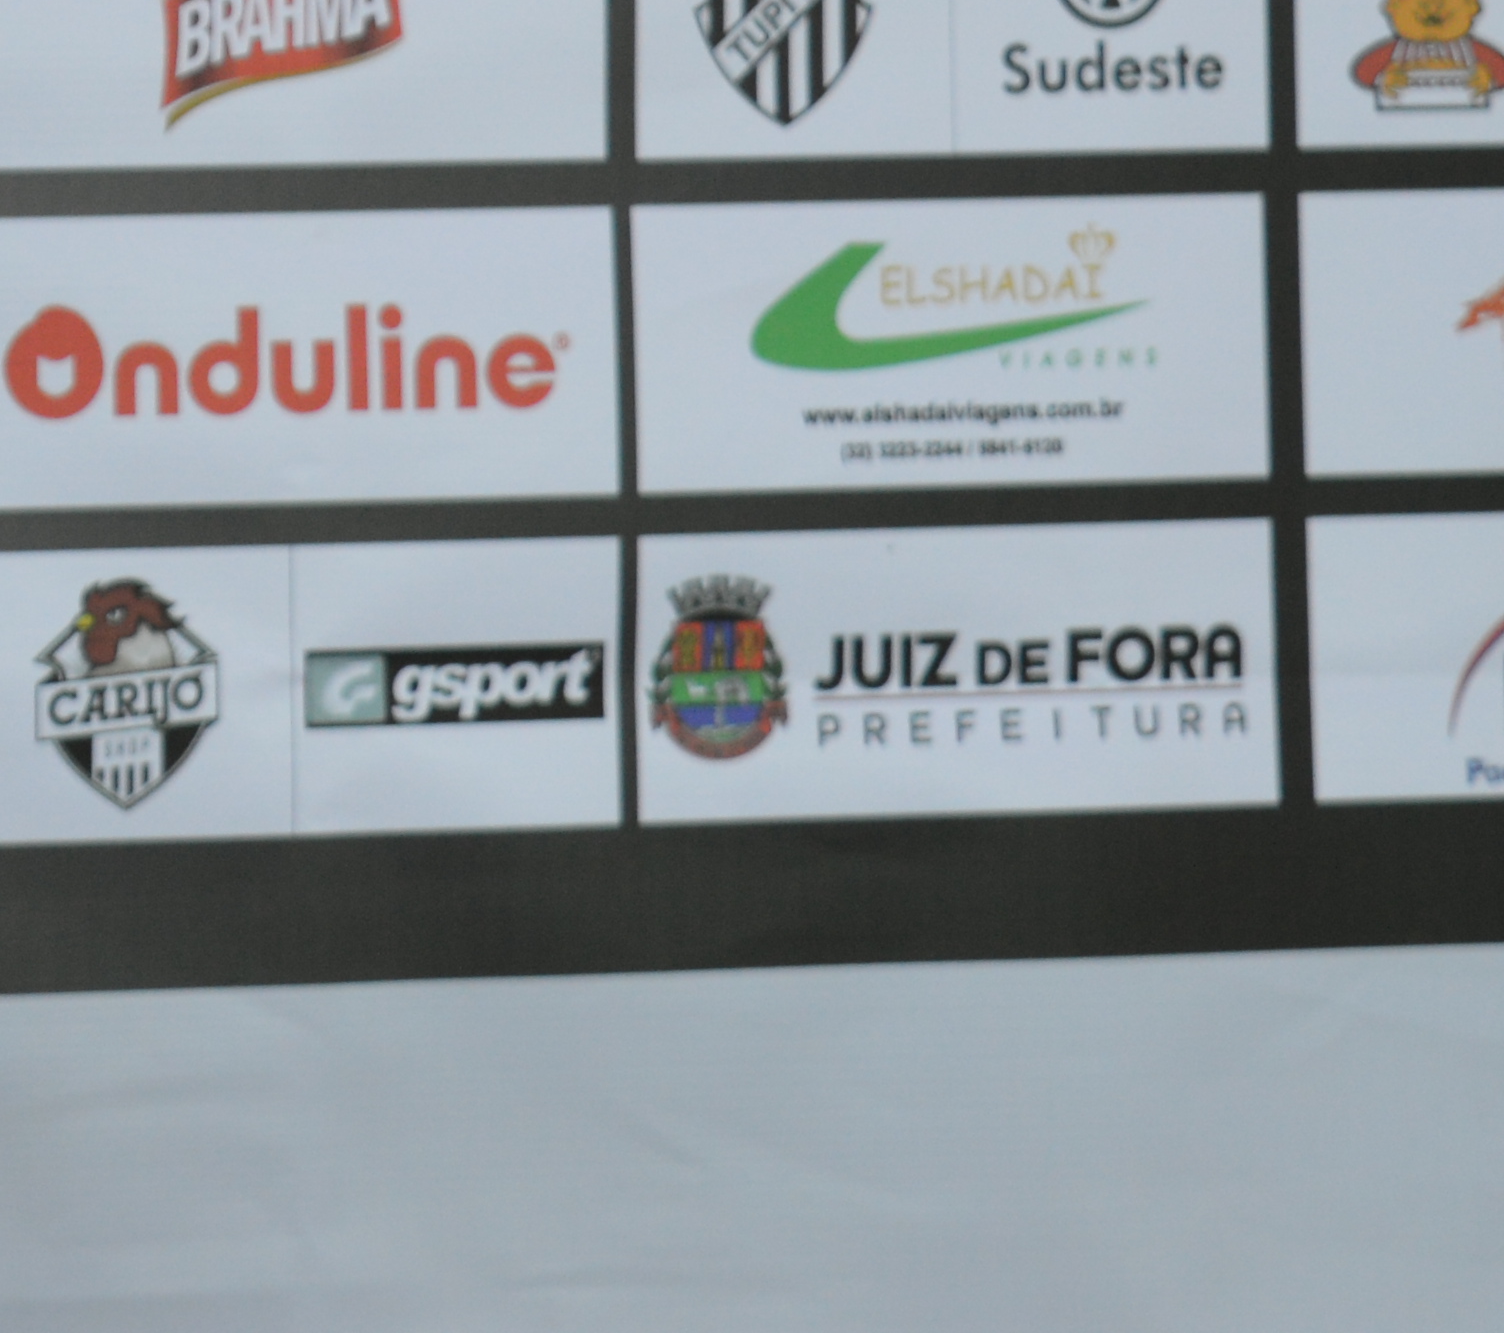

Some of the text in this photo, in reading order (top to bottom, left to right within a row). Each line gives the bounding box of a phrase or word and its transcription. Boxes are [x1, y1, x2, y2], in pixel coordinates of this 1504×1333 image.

[1002, 40, 1224, 95] Sudeste
[816, 624, 1243, 691] JUIZ DE FORA
[817, 700, 1250, 747] PREFEITURA
